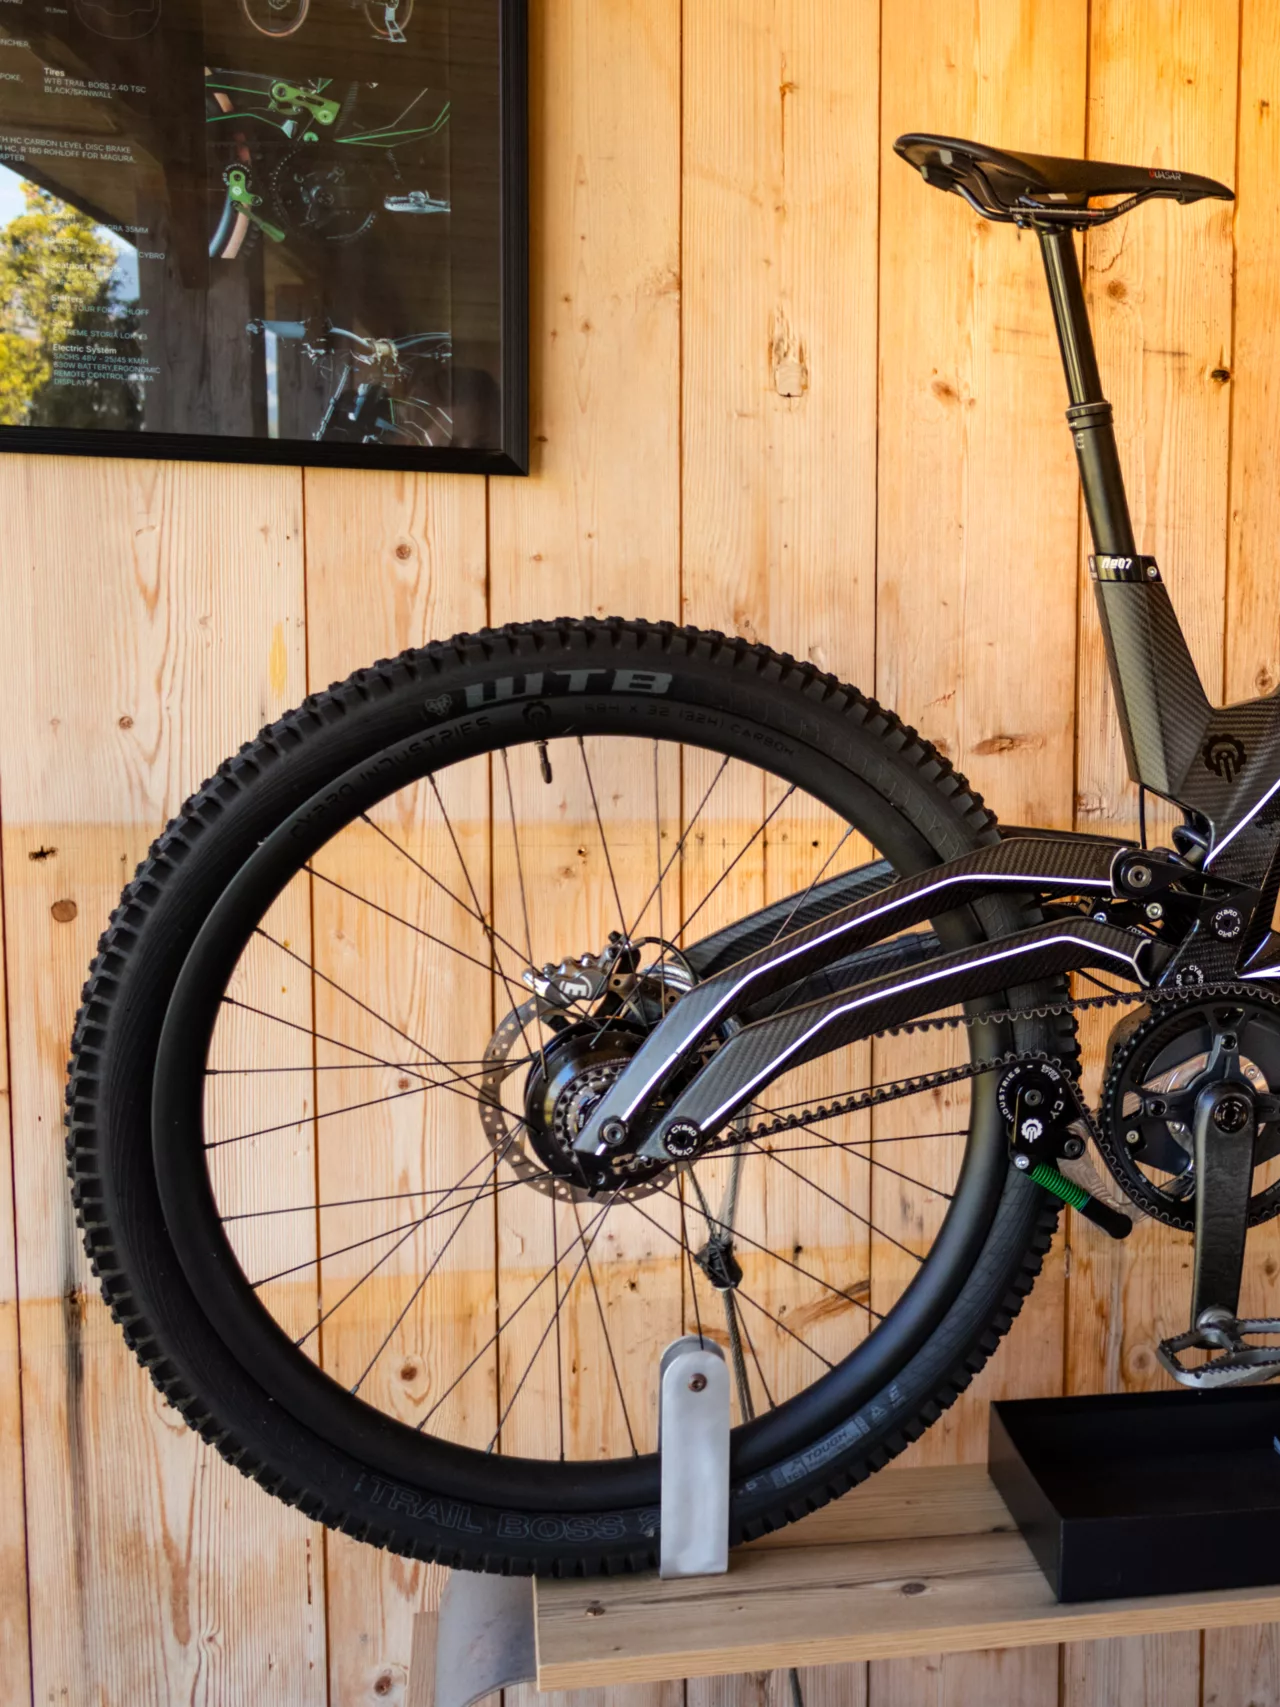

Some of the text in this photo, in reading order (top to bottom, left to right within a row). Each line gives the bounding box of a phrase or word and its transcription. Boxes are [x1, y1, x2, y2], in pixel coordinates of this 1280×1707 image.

[44, 67, 65, 77] Tires
[44, 77, 147, 94] WTB TRAIL BOSS 2.40 TSC
[44, 86, 113, 99] BLACK/SKINWALL
[24, 138, 58, 147] CARBON
[59, 141, 84, 150] LEVEL
[85, 143, 105, 152] DISC
[106, 145, 131, 154] BRAKE
[43, 147, 81, 158] ROHLOFF
[82, 150, 99, 159] FOR
[138, 251, 166, 260] CYBRO
[53, 343, 117, 355] Electric System
[53, 353, 80, 361] SACHS
[53, 370, 85, 378] REMOTE
[464, 668, 673, 708] WTB
[360, 716, 492, 782] INDUSTRIES
[1215, 908, 1238, 921] CYBRO
[1216, 925, 1240, 938] CYBRO
[671, 1124, 697, 1137] CYBRO
[804, 1430, 848, 1462] TOUGH
[369, 1474, 483, 1535] TRAIL
[497, 1512, 628, 1542] BOSS
